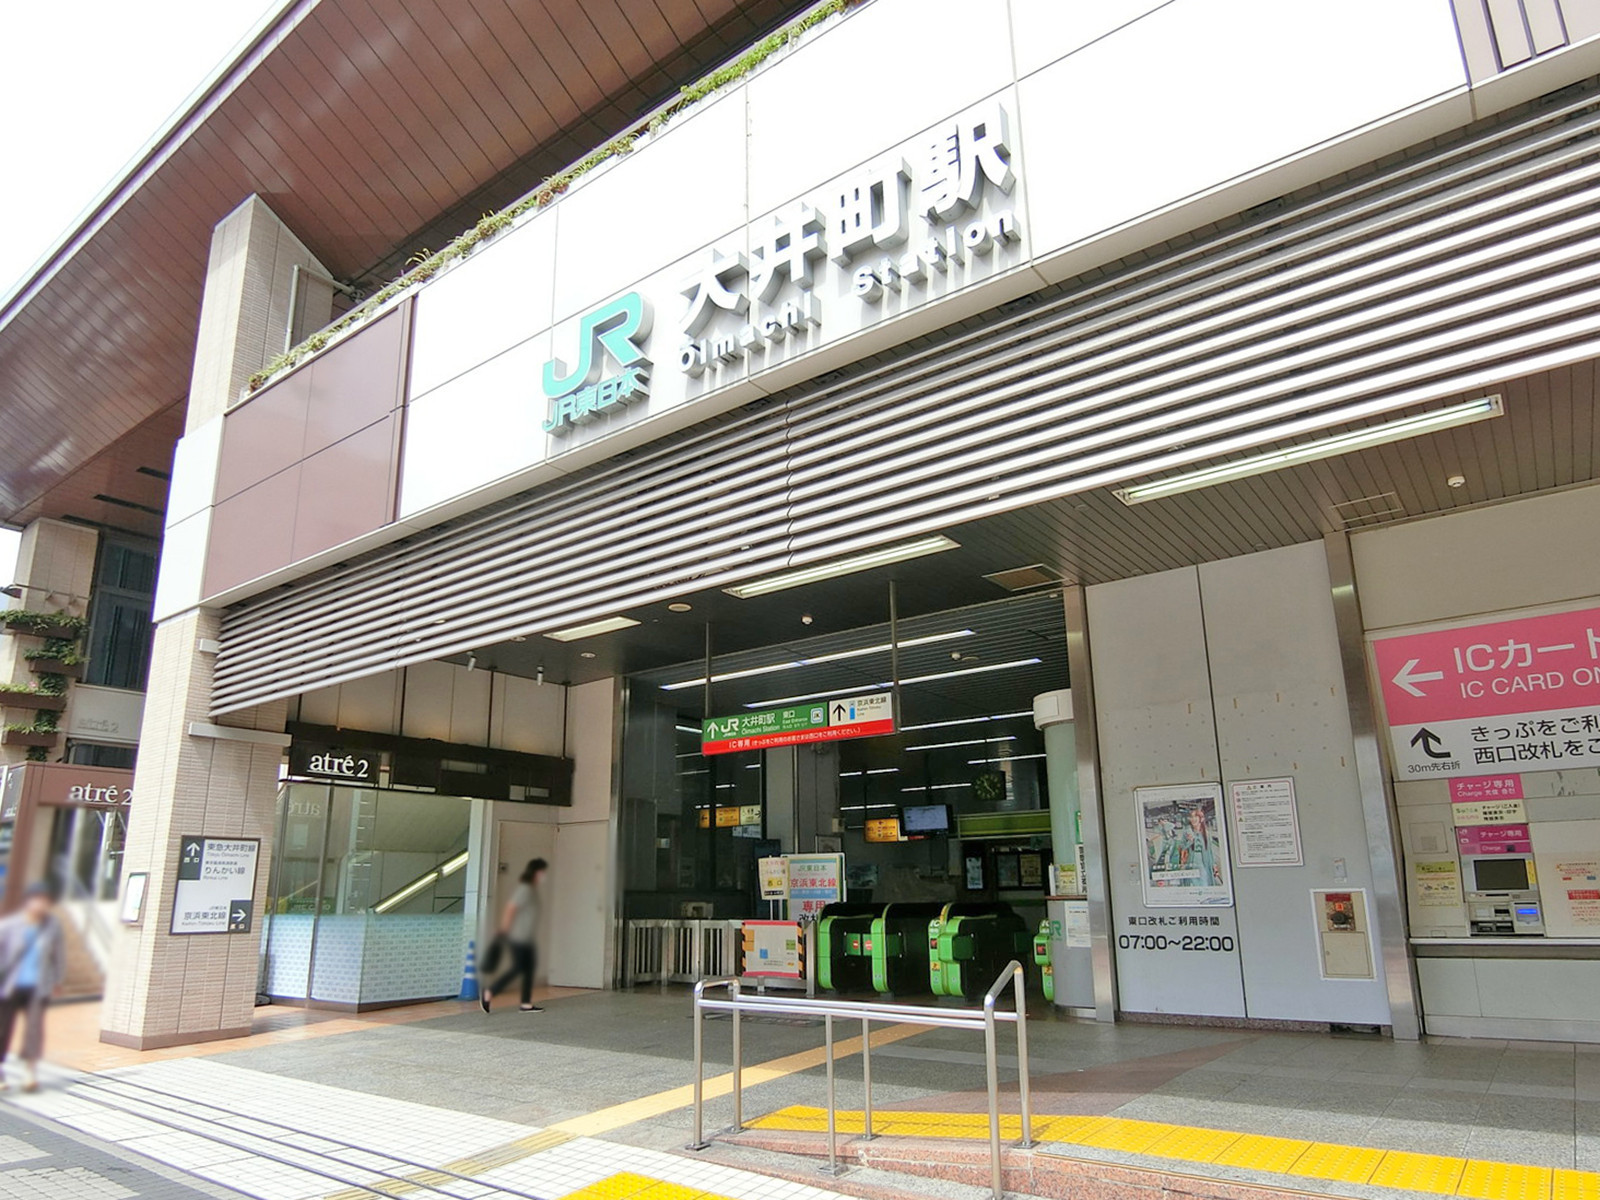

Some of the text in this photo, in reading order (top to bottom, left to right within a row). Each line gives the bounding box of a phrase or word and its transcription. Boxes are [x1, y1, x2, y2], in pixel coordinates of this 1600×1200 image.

[679, 98, 1016, 335] 大井町駅
[542, 290, 651, 398] JR
[541, 366, 650, 433] JR東日本
[1460, 680, 1485, 699] IC
[1491, 671, 1565, 695] CARD
[857, 696, 887, 706] 京浜東北線
[742, 713, 776, 727] 大井町駅
[782, 710, 795, 718] 東口
[721, 718, 739, 733] JR
[308, 752, 369, 778] atré 2
[1408, 760, 1461, 774] 30m先右折
[1456, 779, 1515, 791] チャージ専用
[70, 782, 118, 806] atré
[1480, 829, 1523, 838] チャージ専用
[206, 842, 256, 853] 東急大井町線
[205, 866, 246, 875] りんかい線
[790, 877, 837, 889] 京浜東北線
[183, 911, 227, 920] 京浜東北線
[1128, 916, 1220, 927] 東口改札ご利用時間
